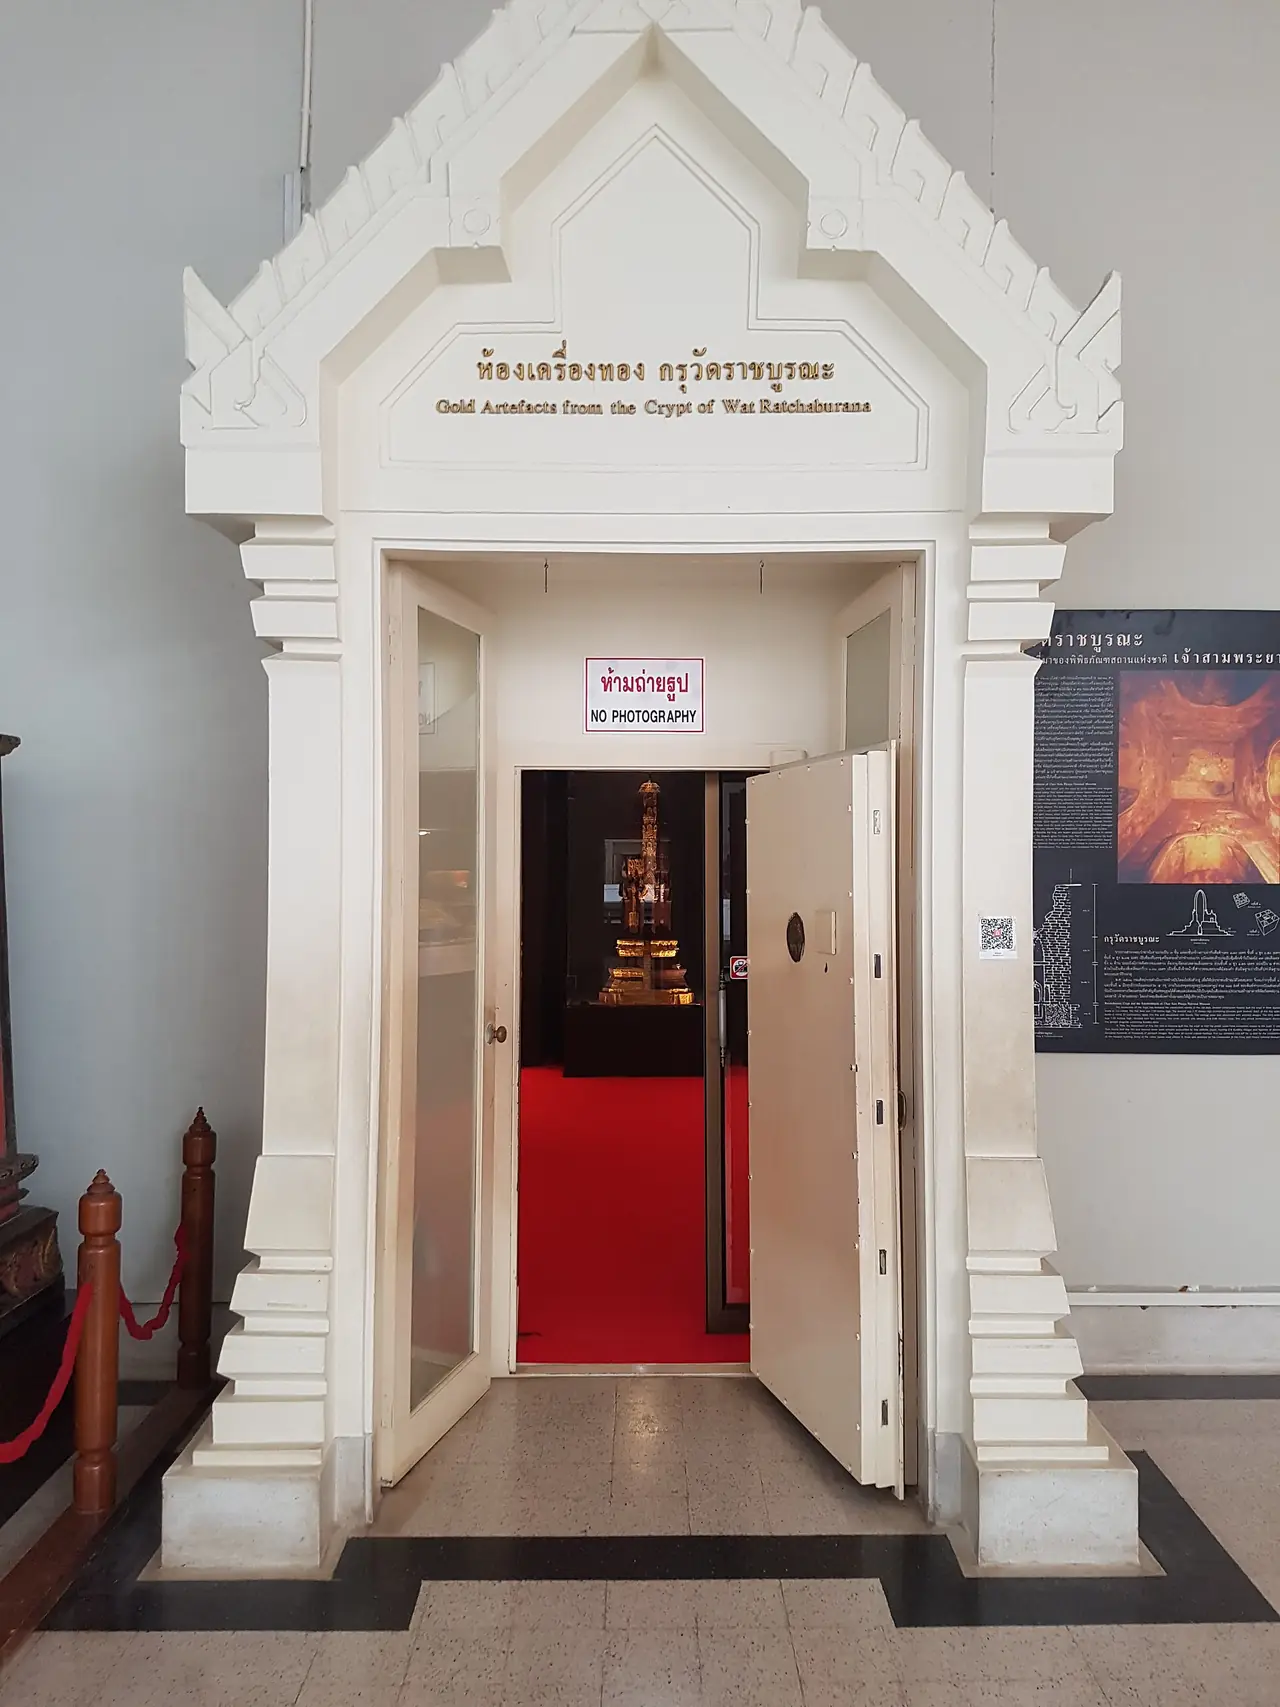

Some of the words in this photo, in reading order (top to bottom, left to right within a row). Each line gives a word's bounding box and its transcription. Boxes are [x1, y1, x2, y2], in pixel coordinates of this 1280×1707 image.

[476, 340, 646, 382] ห้องเครื่องทอง
[659, 347, 835, 394] กรุวัดราชบูรณะ
[436, 399, 476, 414] Gold
[480, 399, 558, 415] Artefacts
[562, 399, 604, 415] from
[610, 399, 637, 415] the
[644, 399, 693, 418] Crypt
[697, 399, 715, 414] of
[722, 399, 756, 414] Wat
[759, 399, 872, 414] Ratchaburana
[600, 667, 689, 702] ห้ามถ่ายรูป
[590, 709, 608, 723] NO
[611, 709, 697, 723] PHOTOGRAPHY
